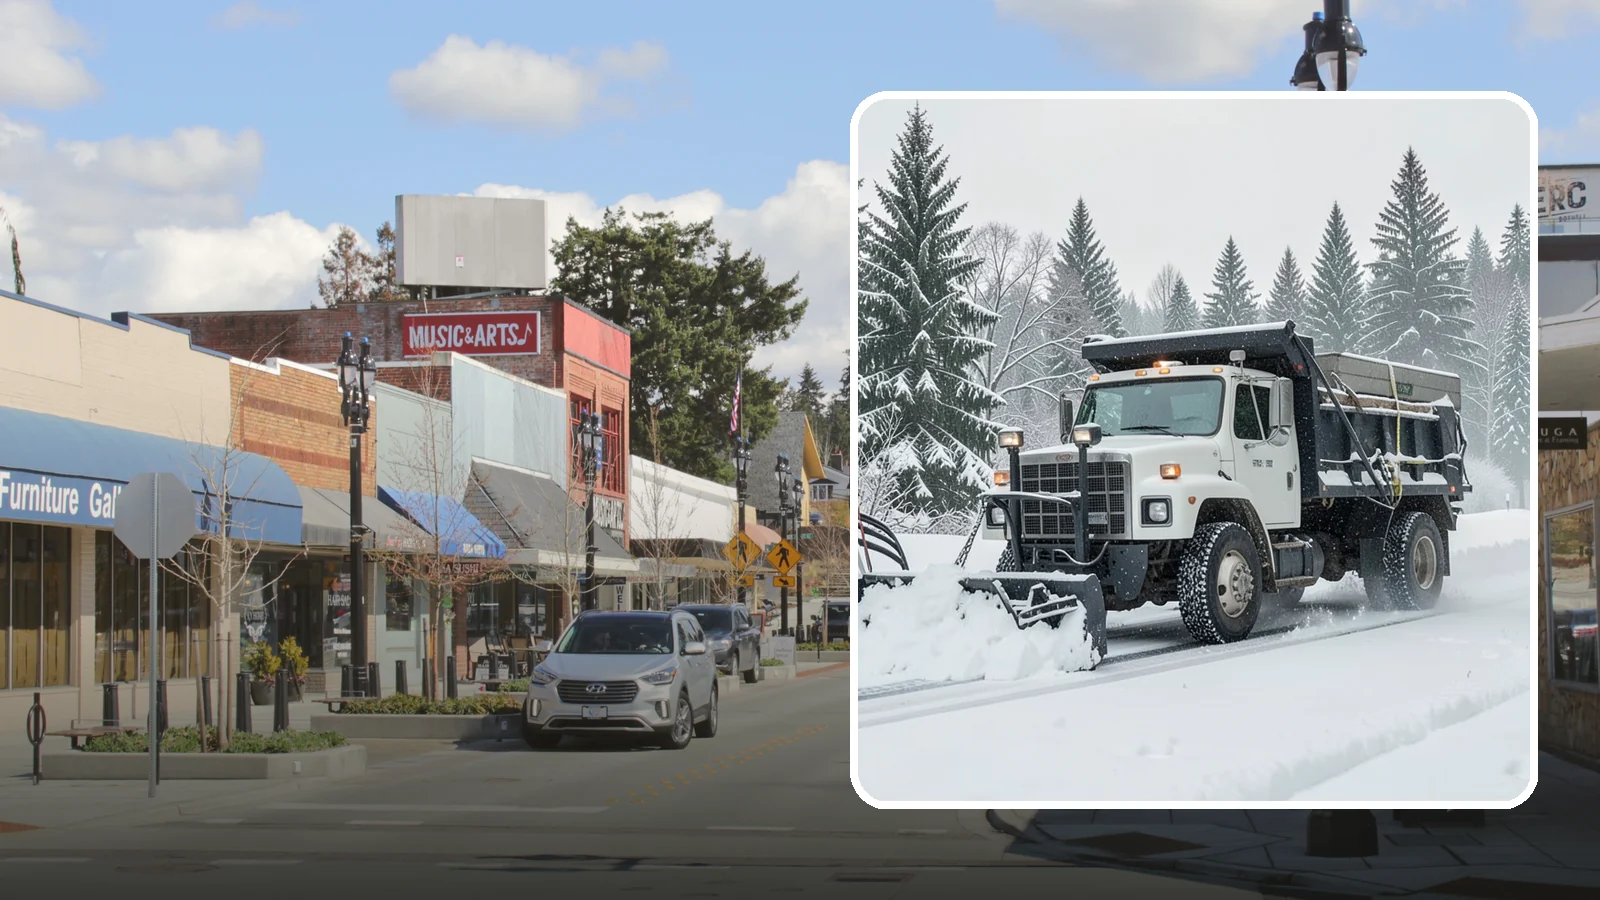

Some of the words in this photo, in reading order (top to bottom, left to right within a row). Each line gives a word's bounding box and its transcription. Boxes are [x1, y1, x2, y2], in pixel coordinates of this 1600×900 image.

[0, 472, 79, 515] Furniture
[89, 482, 122, 519] Gal
[453, 563, 479, 573] SUSHI
